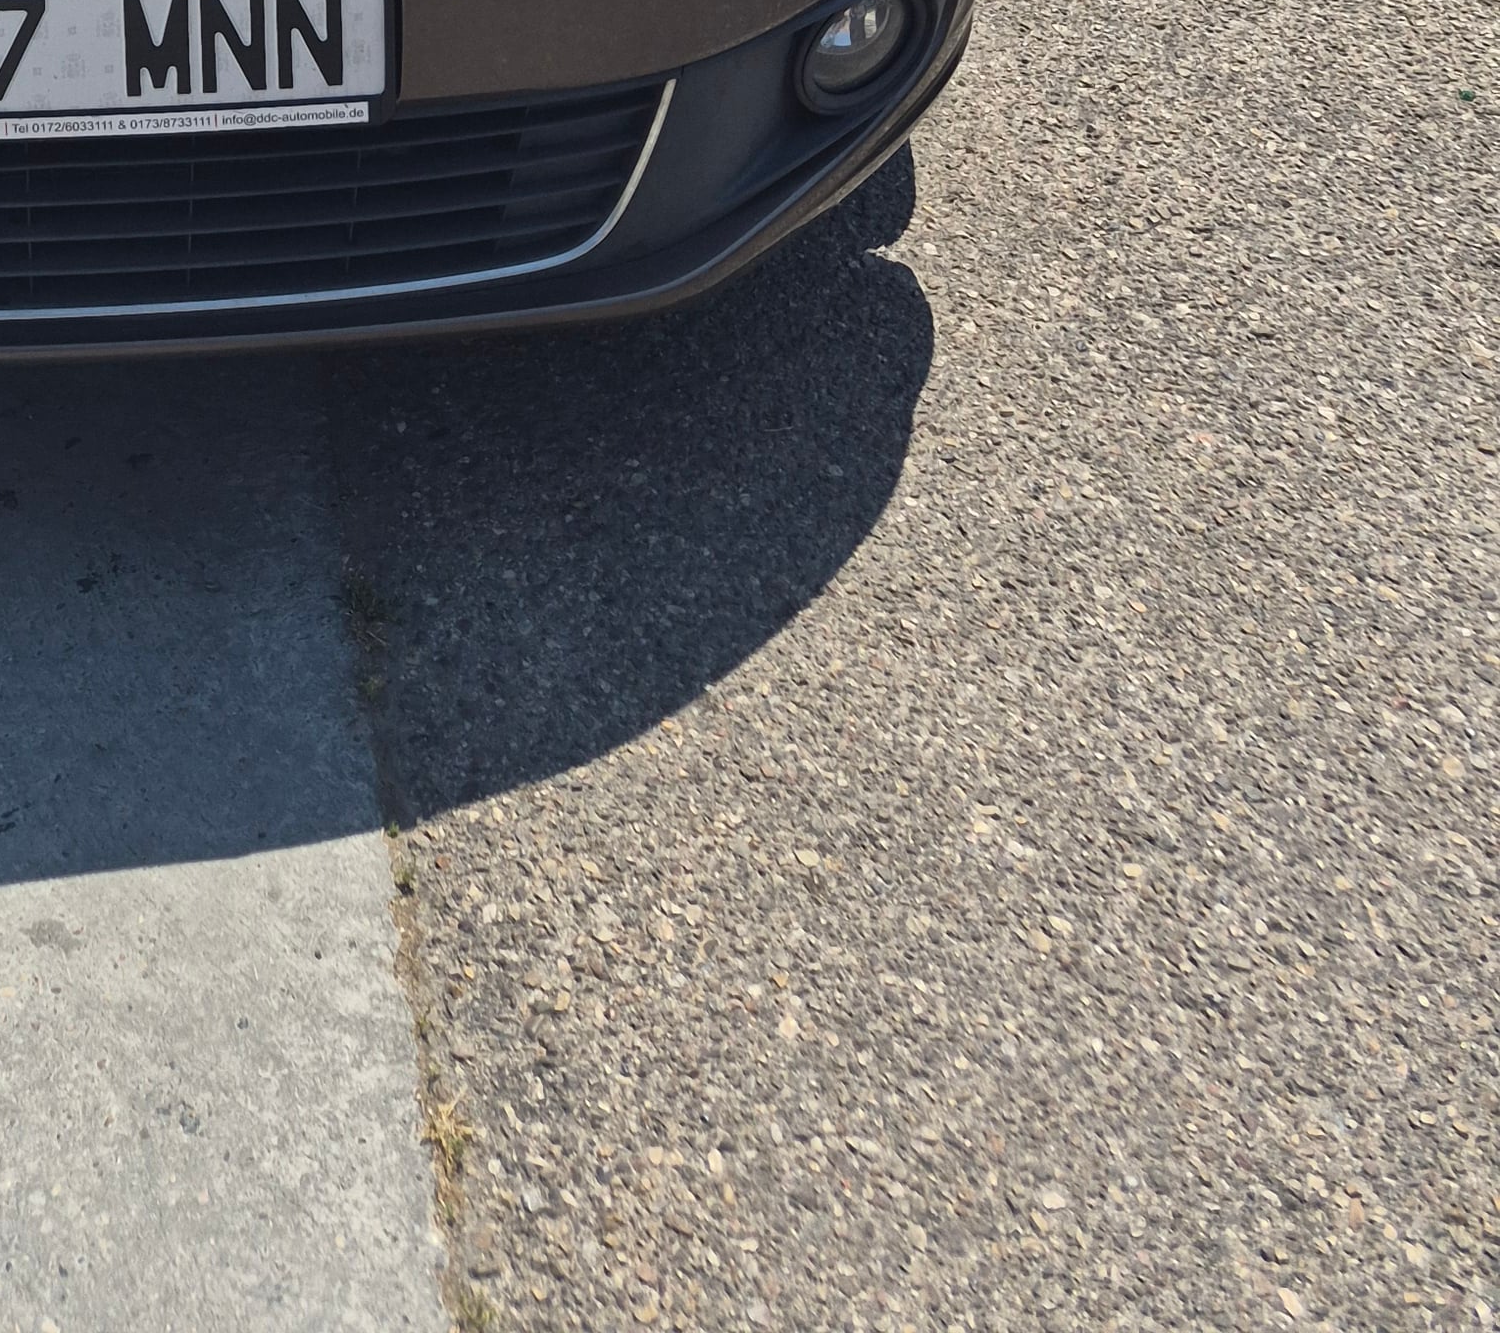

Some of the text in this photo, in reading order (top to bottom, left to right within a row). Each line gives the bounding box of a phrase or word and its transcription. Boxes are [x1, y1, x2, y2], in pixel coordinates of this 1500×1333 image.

[11, 123, 29, 134] Tel
[32, 120, 114, 133] 0172/6033111
[117, 120, 126, 130] &
[129, 116, 212, 129] 0173/8733111
[221, 107, 365, 126] info@ddc-automobile.de
